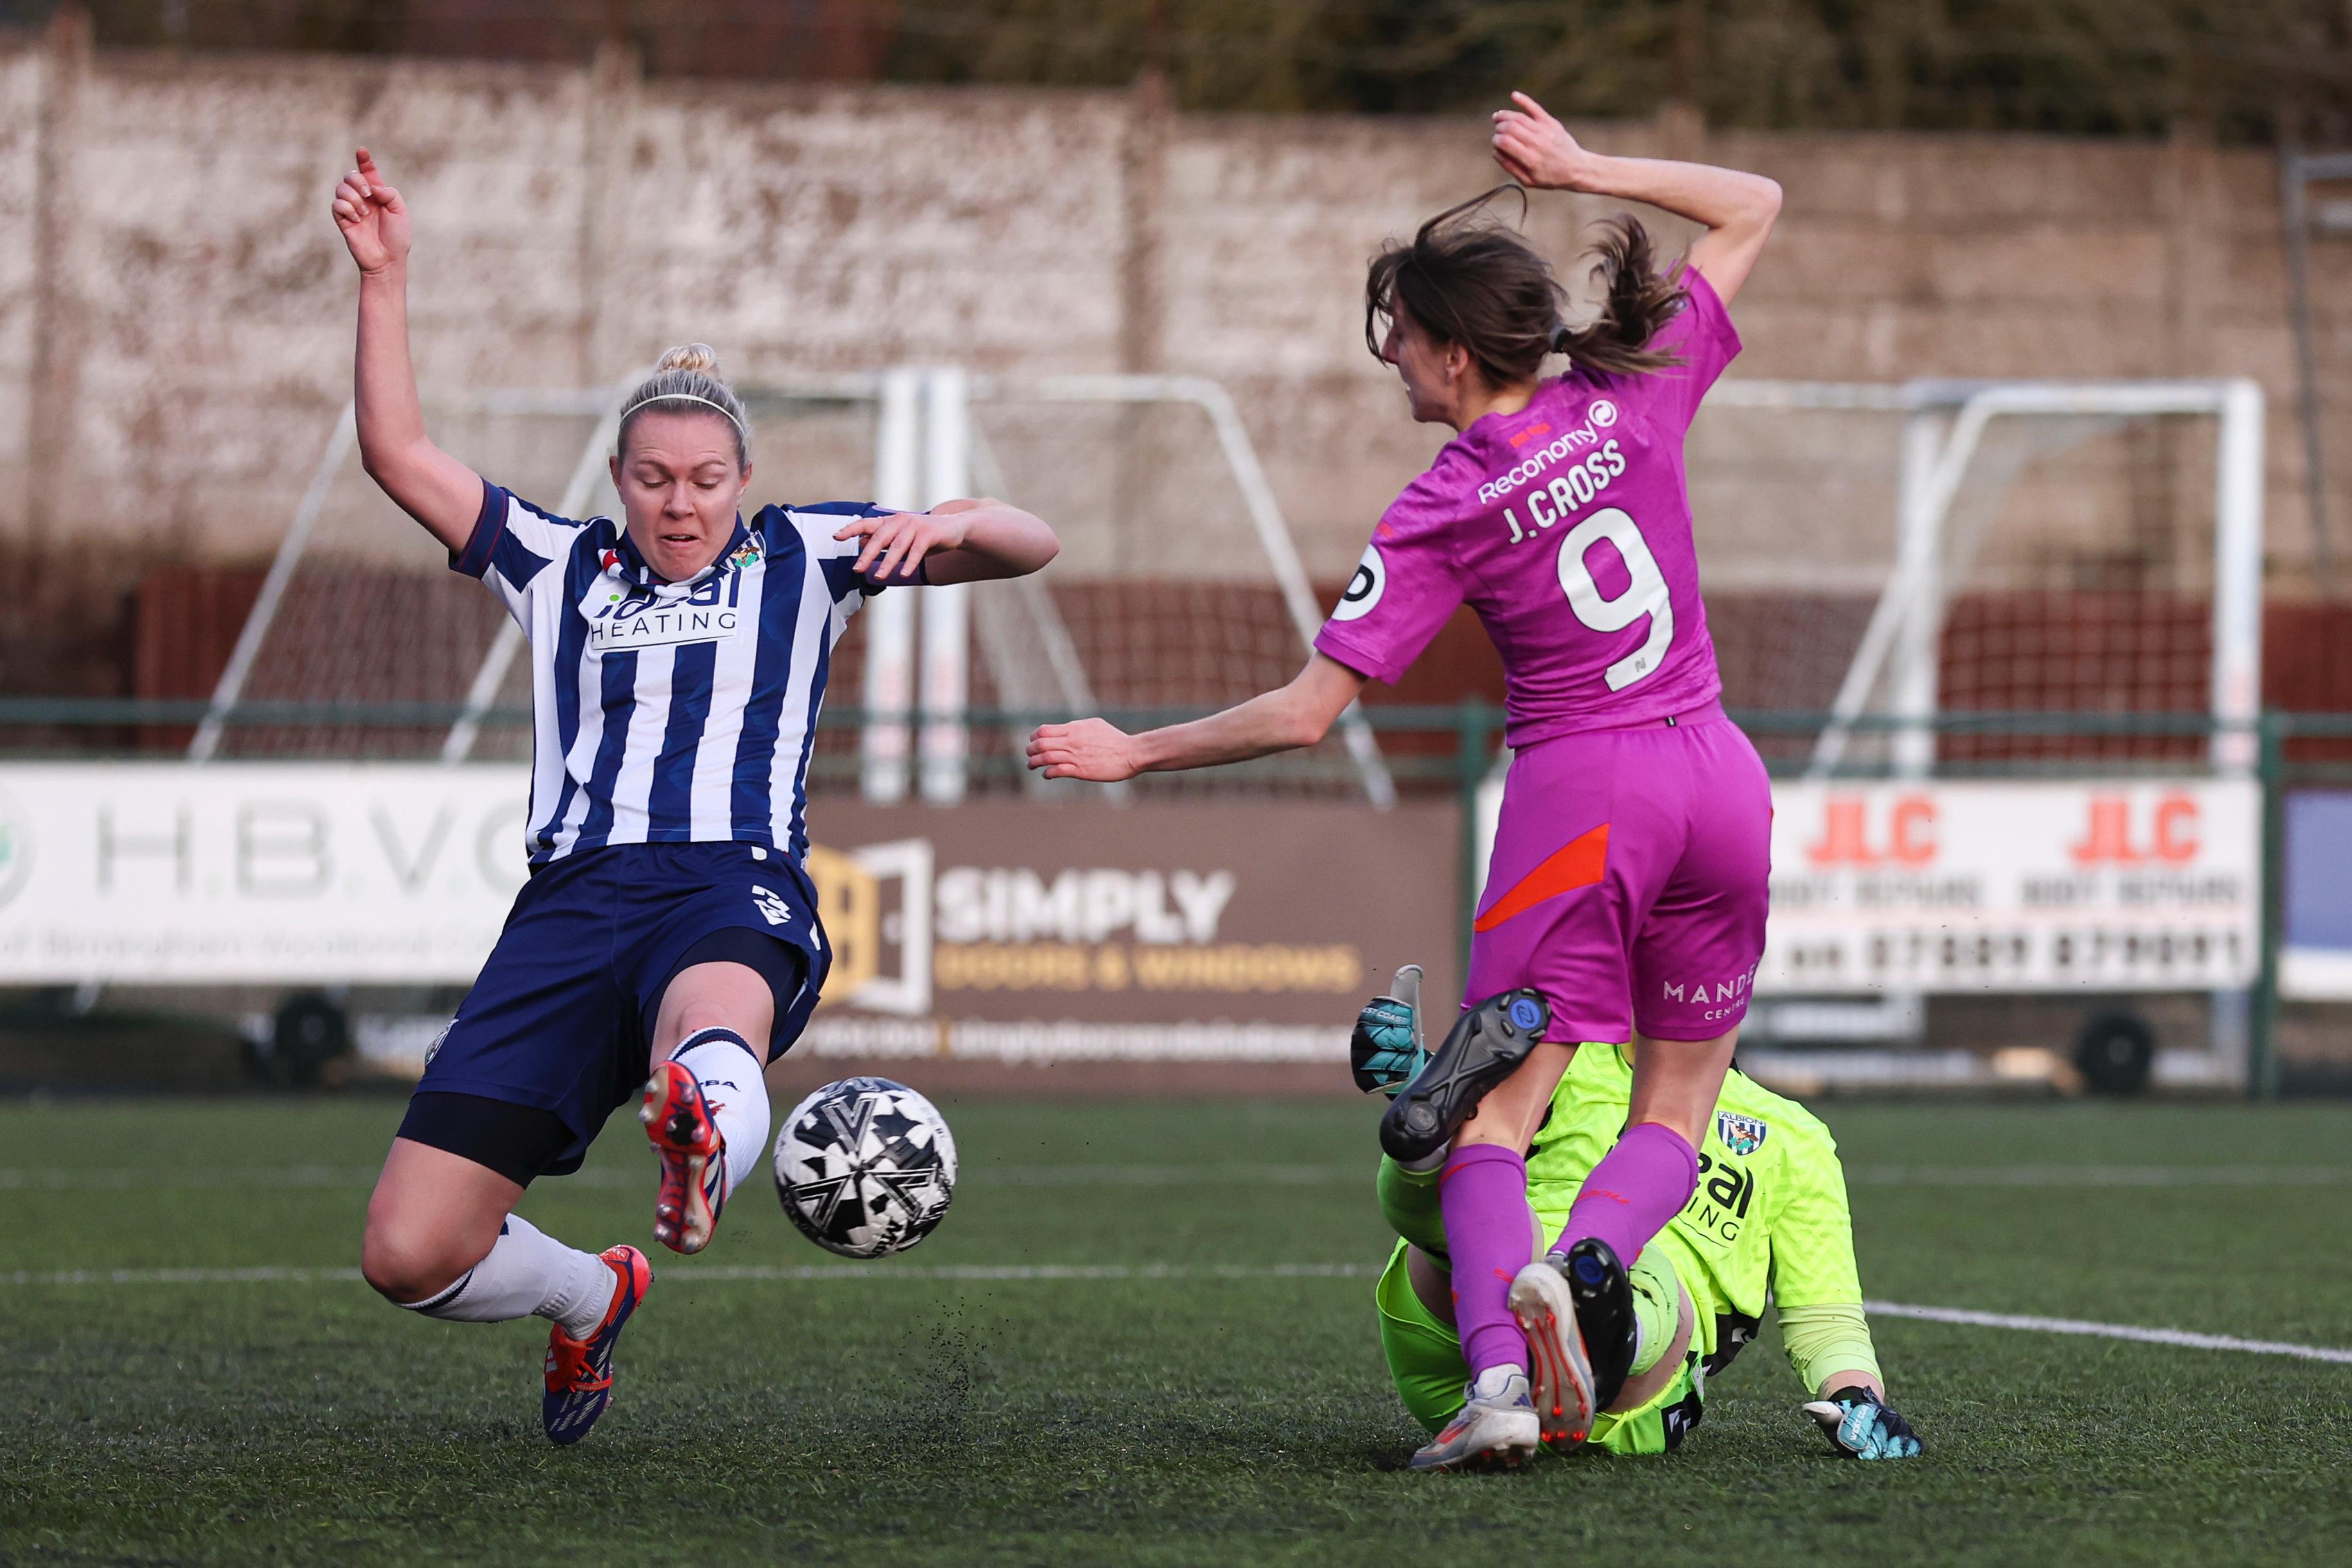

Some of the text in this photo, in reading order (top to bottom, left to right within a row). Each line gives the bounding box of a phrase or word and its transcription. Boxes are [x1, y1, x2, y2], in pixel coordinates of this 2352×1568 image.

[1478, 419, 1599, 505] Reconomy
[1558, 507, 1674, 693] 9
[590, 612, 736, 642] HEATING
[935, 867, 1236, 943] SIMPLY
[1663, 962, 1758, 1004] MANDE
[1377, 1011, 1409, 1023] COAST
[1720, 1112, 1764, 1126] ALBION
